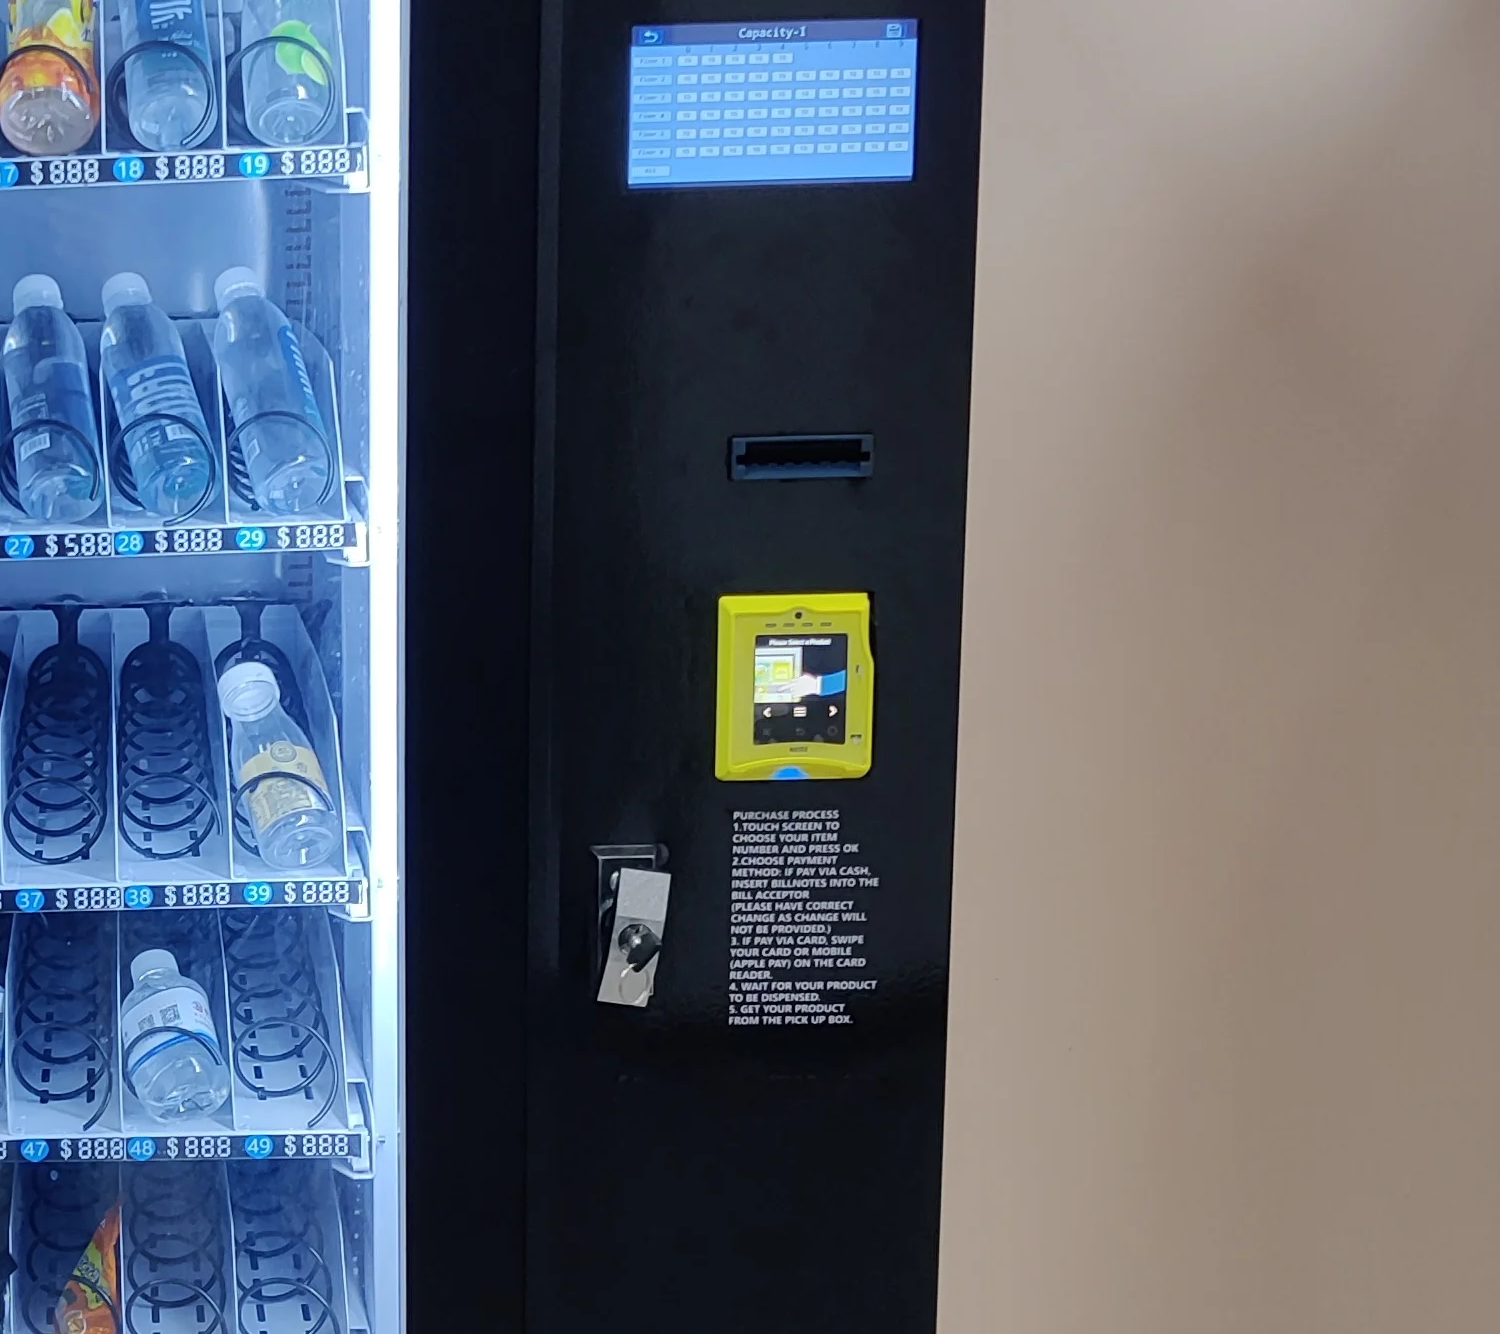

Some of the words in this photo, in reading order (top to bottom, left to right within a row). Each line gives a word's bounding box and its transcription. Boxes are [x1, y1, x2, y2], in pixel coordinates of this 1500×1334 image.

[244, 157, 265, 174] 19
[120, 163, 141, 180] 18
[240, 530, 263, 546] 29
[9, 539, 30, 555] 27
[733, 811, 789, 820] PURCHASE
[792, 810, 839, 819] PROCESS
[782, 822, 822, 831] SCREEN
[825, 821, 840, 830] TO
[732, 834, 776, 843] CHOOSE
[779, 833, 808, 842] YOUR
[811, 833, 838, 842] ITEM
[732, 845, 779, 854] NUMBER
[782, 845, 806, 854] AND
[809, 844, 840, 853] PRESS
[843, 844, 859, 852] OK
[787, 856, 838, 865] PAYMENT
[784, 868, 794, 876] IF
[796, 867, 815, 876] PAY
[819, 867, 836, 876] VIA
[732, 879, 768, 889] INSERT
[771, 879, 827, 888] BILLNOTES
[830, 878, 856, 887] INTO
[859, 878, 879, 887] THE
[247, 887, 269, 901] 39
[731, 891, 753, 900] BILL
[755, 890, 809, 899] ACCEPTOR
[19, 893, 40, 908] 37
[775, 902, 803, 911] HAVE
[806, 901, 854, 910] CORRECT
[731, 914, 775, 923] CHANGE
[778, 913, 791, 922] AS
[794, 913, 838, 922] CHANGE
[841, 912, 867, 921] WILL
[731, 925, 752, 934] NOT
[756, 925, 768, 934] BE
[742, 936, 752, 945] IF
[754, 936, 773, 945] PAY
[776, 936, 794, 945] VIA
[831, 935, 864, 944] SWIPE
[730, 948, 759, 957] YOUR
[762, 948, 791, 956] CARD
[794, 947, 809, 956] OR
[812, 947, 852, 956] MOBILE
[794, 959, 810, 967] ON
[813, 958, 834, 967] THE
[836, 958, 866, 967] CARD
[741, 982, 768, 991] WAIT
[771, 982, 792, 990] FOR
[795, 981, 824, 990] YOUR
[827, 980, 877, 989] PRODUCT
[729, 994, 743, 1002] TO
[746, 993, 758, 1002] BE
[740, 1005, 760, 1014] GET
[763, 1005, 792, 1013] YOUR
[795, 1004, 845, 1012] PRODUCT
[729, 1016, 759, 1025] FROM
[762, 1016, 782, 1025] THE
[785, 1016, 808, 1025] PICK
[811, 1015, 826, 1024] UP
[24, 1143, 46, 1157] 47
[248, 1139, 271, 1153] 49
